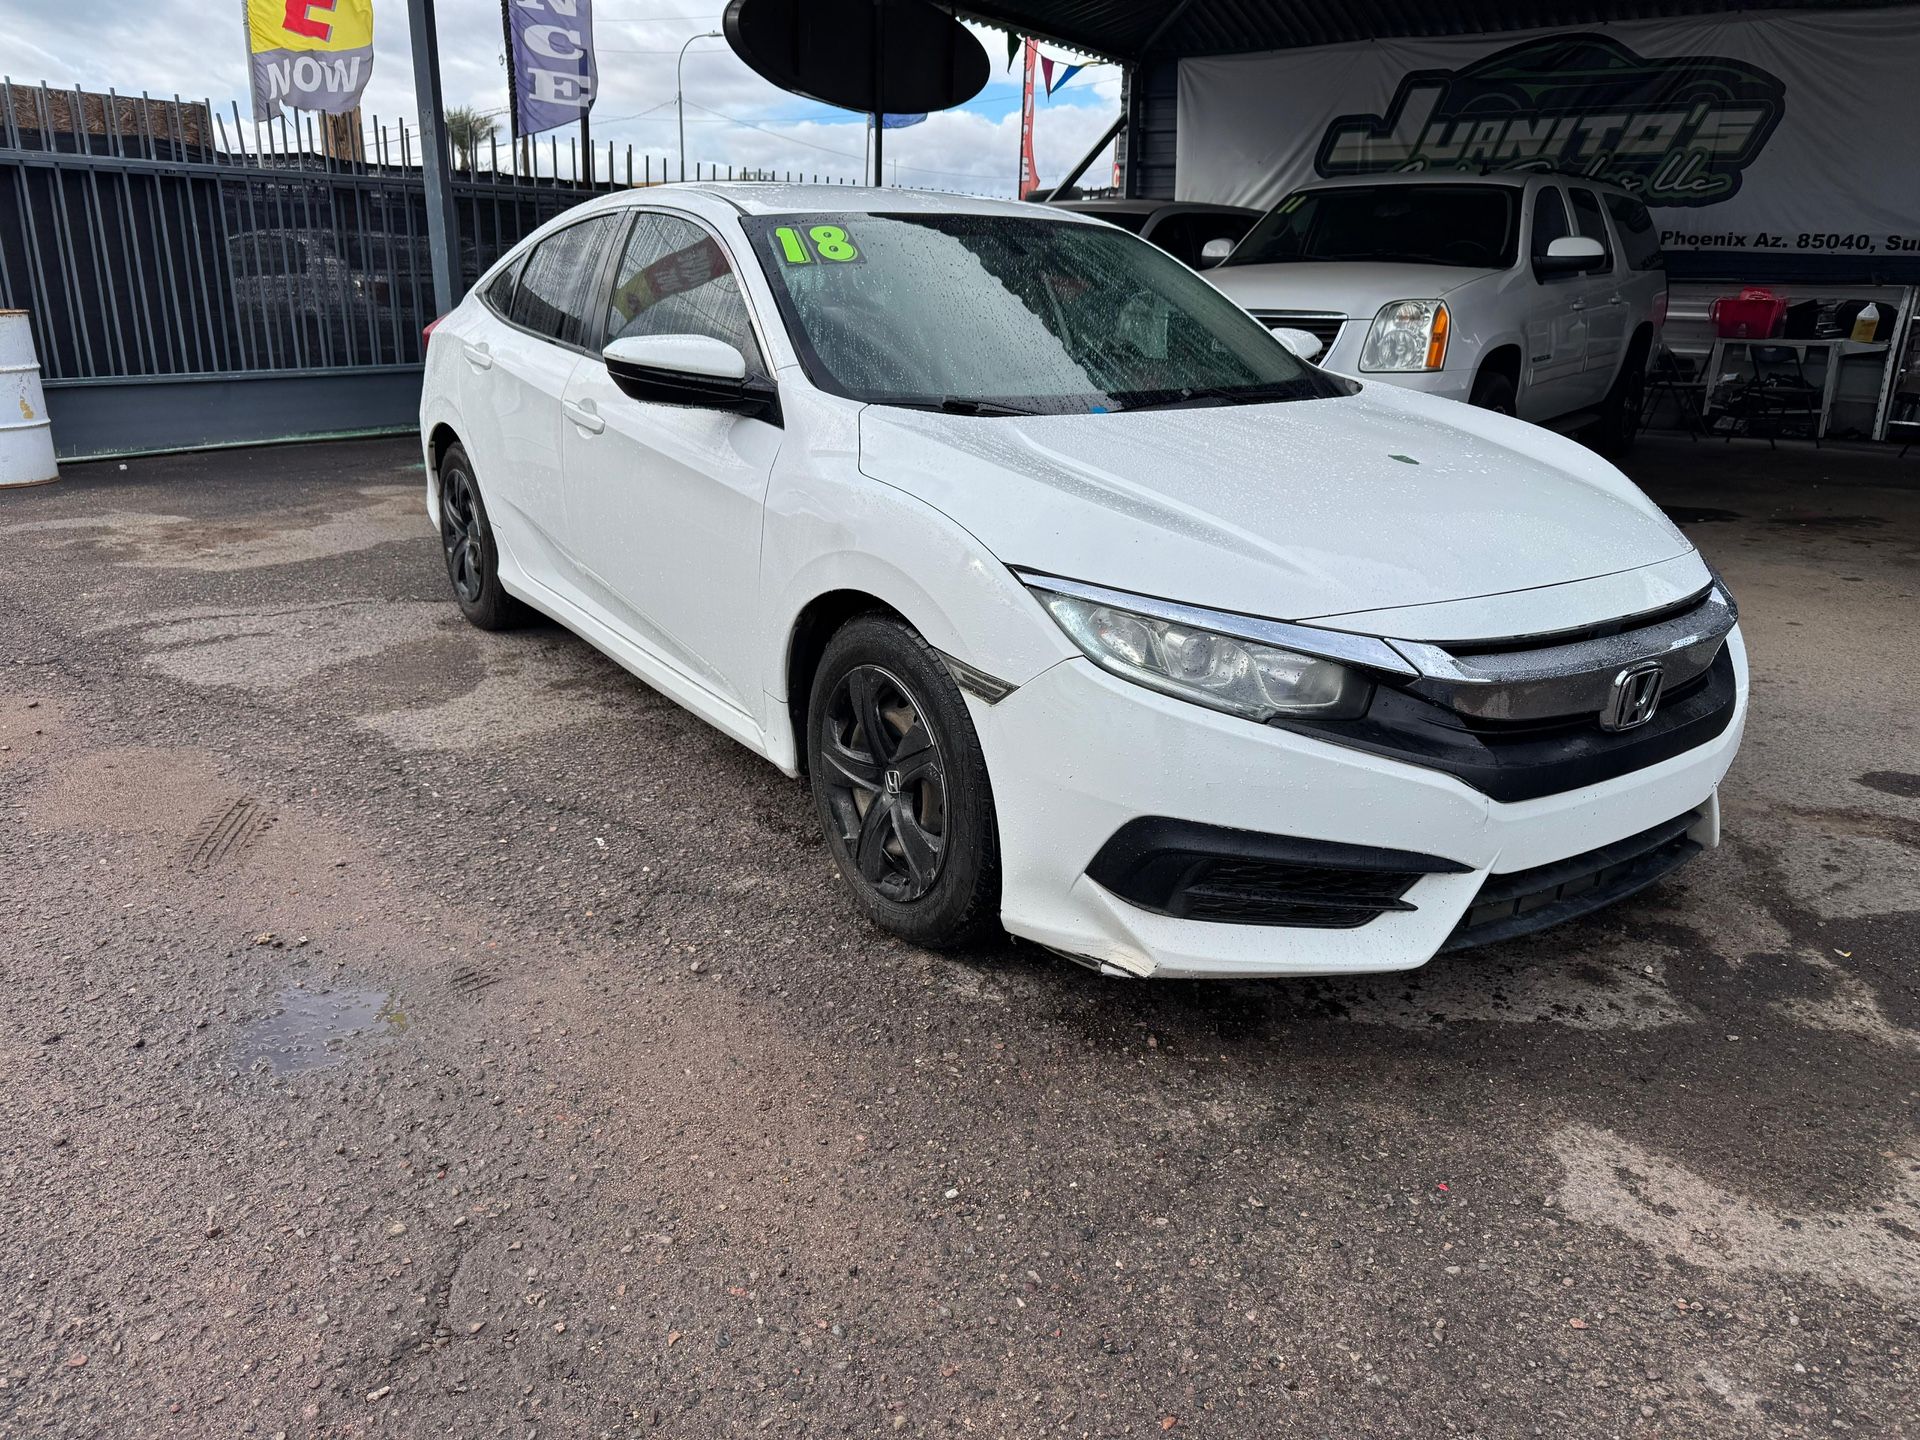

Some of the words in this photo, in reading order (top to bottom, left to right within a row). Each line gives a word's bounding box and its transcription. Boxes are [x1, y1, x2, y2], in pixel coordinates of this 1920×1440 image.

[267, 56, 361, 99] NOW
[1328, 87, 1765, 163] JUANITO'S
[776, 226, 858, 264] 18
[1660, 231, 1747, 247] Phoenix
[1754, 232, 1788, 248] Az.
[1797, 233, 1876, 253] 85040,
[1885, 235, 1920, 251] Su
